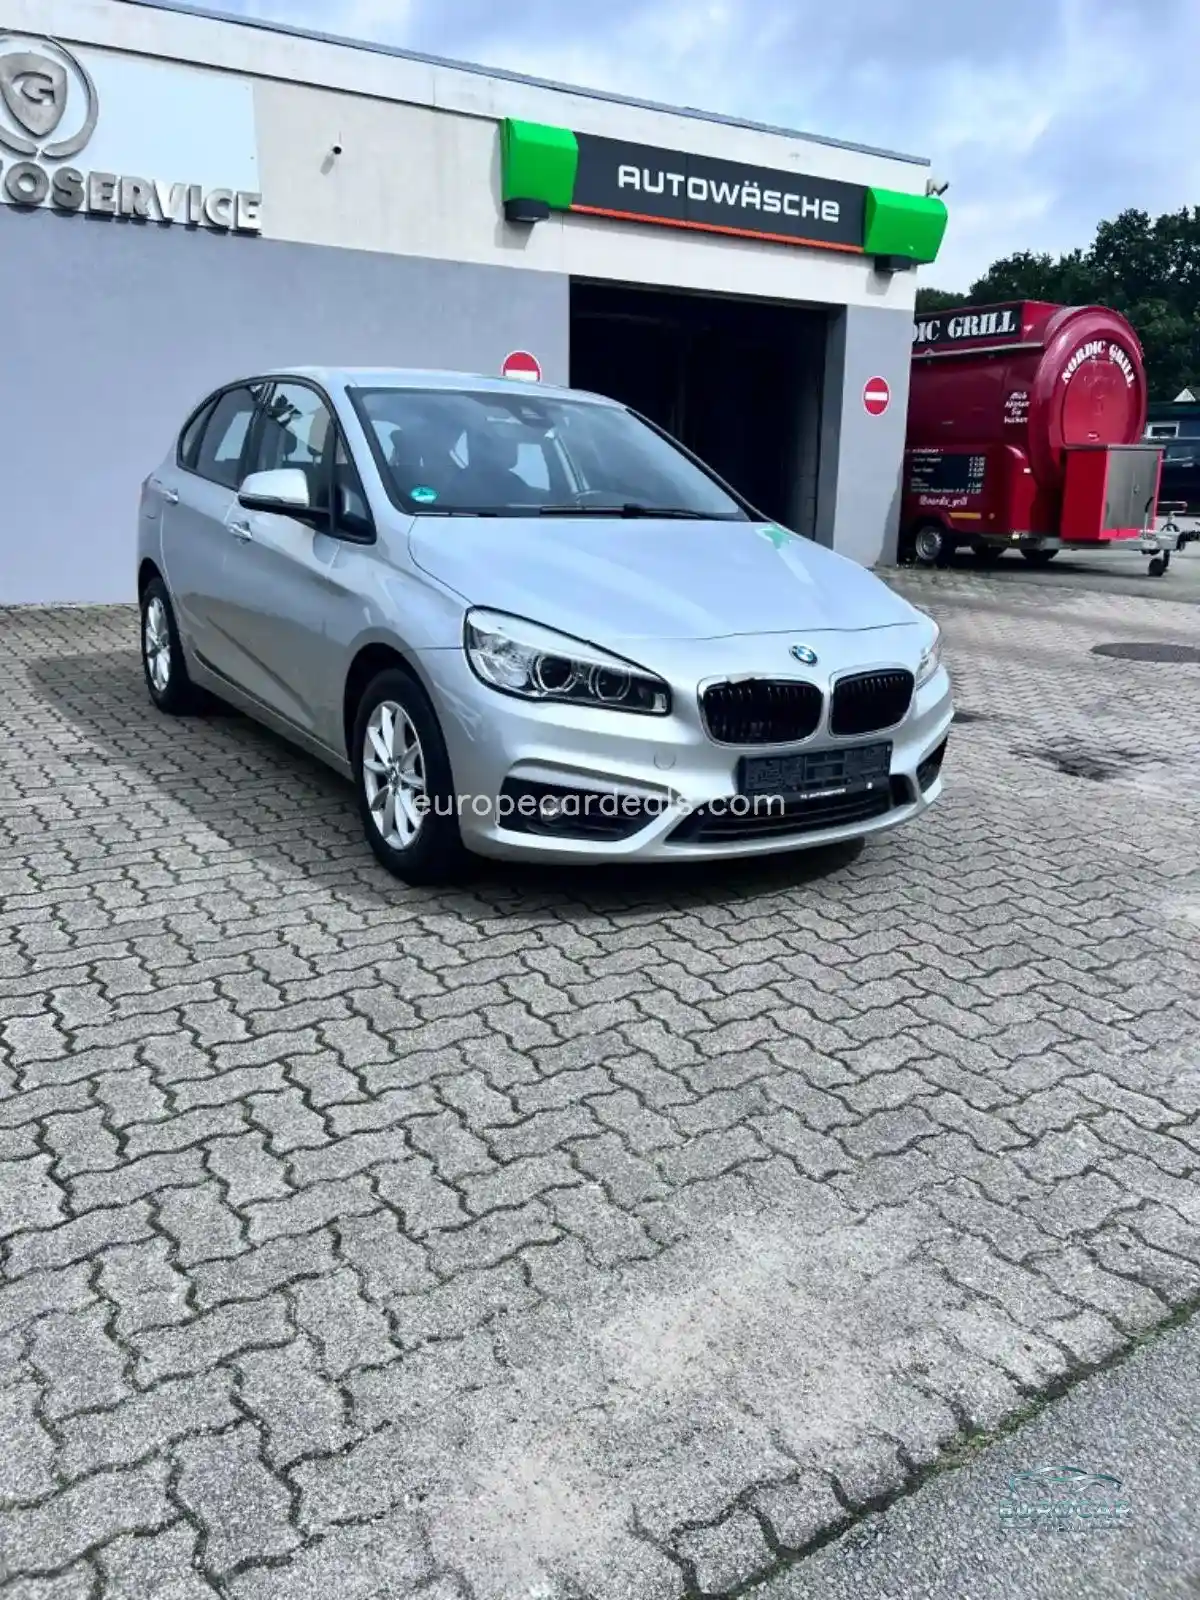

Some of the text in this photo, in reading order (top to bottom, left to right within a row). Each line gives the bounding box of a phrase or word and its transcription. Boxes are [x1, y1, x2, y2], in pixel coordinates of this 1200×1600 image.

[0, 160, 263, 232] OSERVICE
[947, 310, 1016, 339] GRILL
[1061, 340, 1135, 388] NORDIC GRILL
